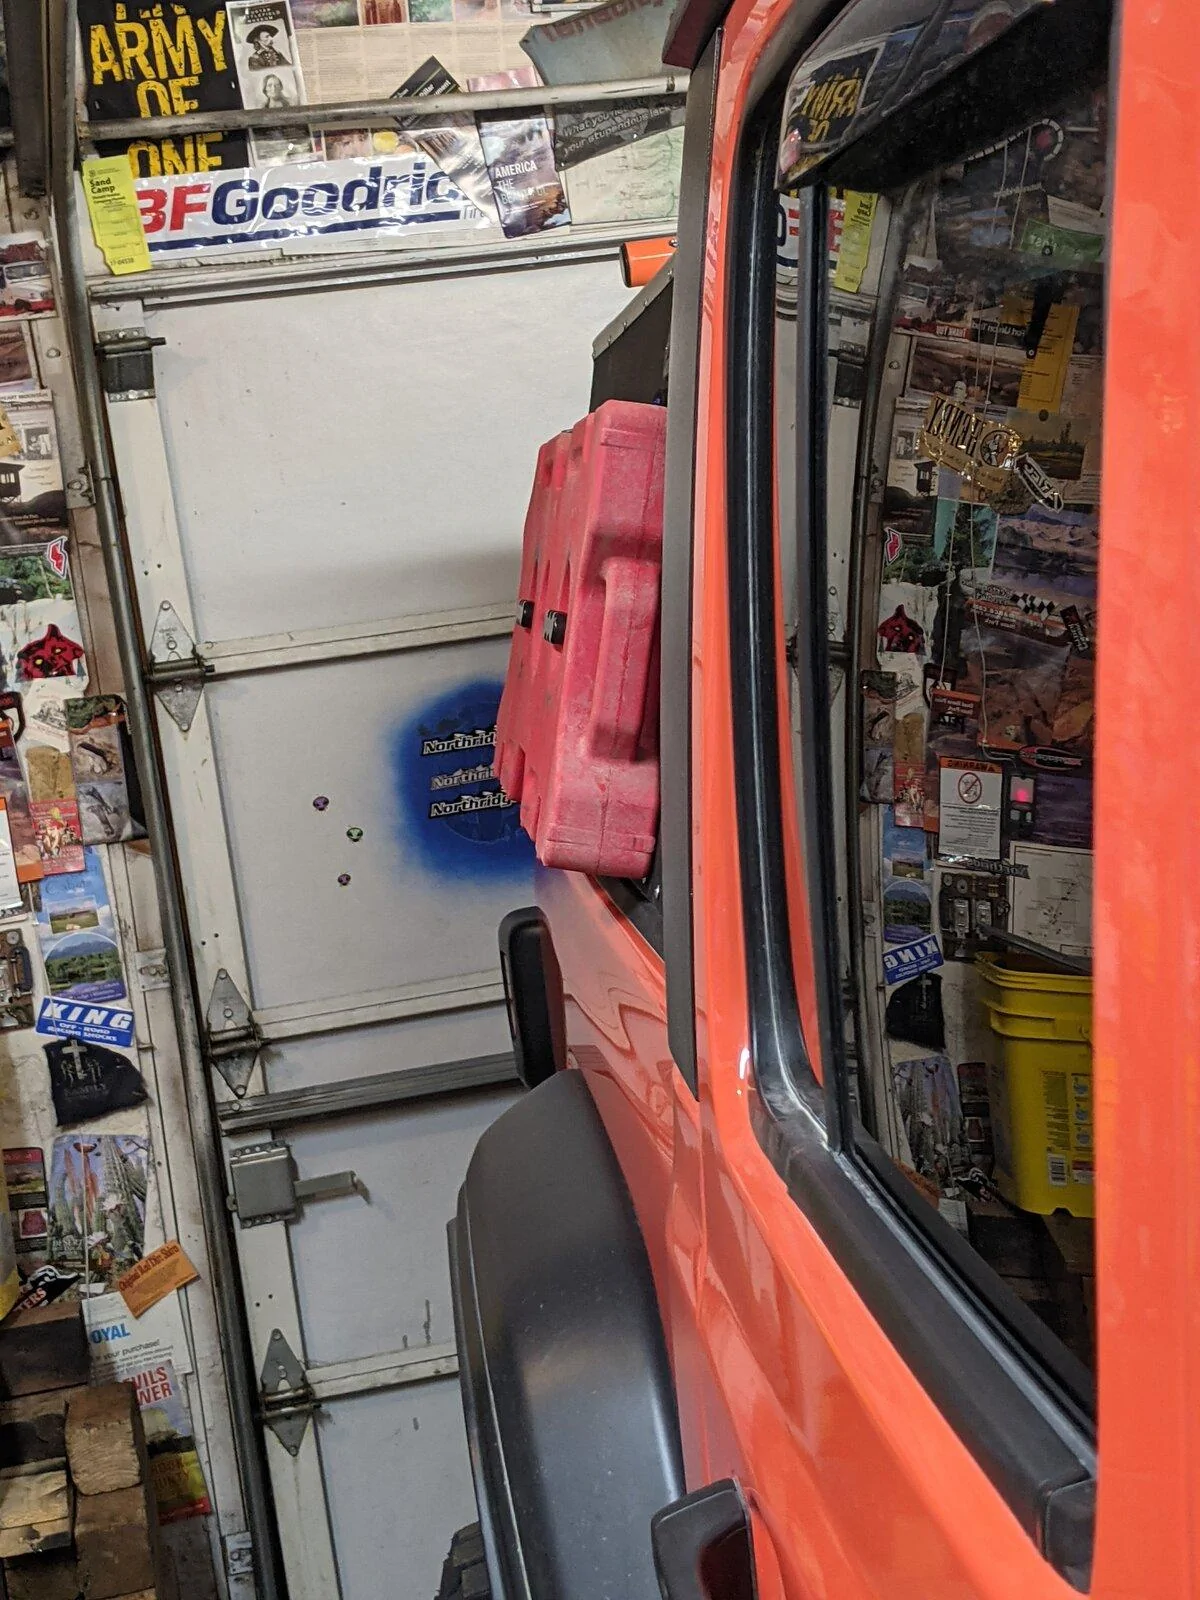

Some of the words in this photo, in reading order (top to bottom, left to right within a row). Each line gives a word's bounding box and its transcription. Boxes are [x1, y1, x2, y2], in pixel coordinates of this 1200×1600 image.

[90, 10, 228, 86] ARMY
[137, 76, 200, 118] OF
[128, 131, 224, 179] ONE
[495, 160, 538, 178] AMERICA
[89, 178, 112, 188] Sand
[91, 185, 116, 195] Camp
[497, 178, 516, 190] THE
[137, 162, 470, 233] BFGoodric
[423, 730, 498, 754] Northrid
[431, 793, 515, 816] Northridg
[42, 1003, 133, 1029] KING
[103, 1347, 122, 1360] your
[123, 1338, 161, 1355] purchase!
